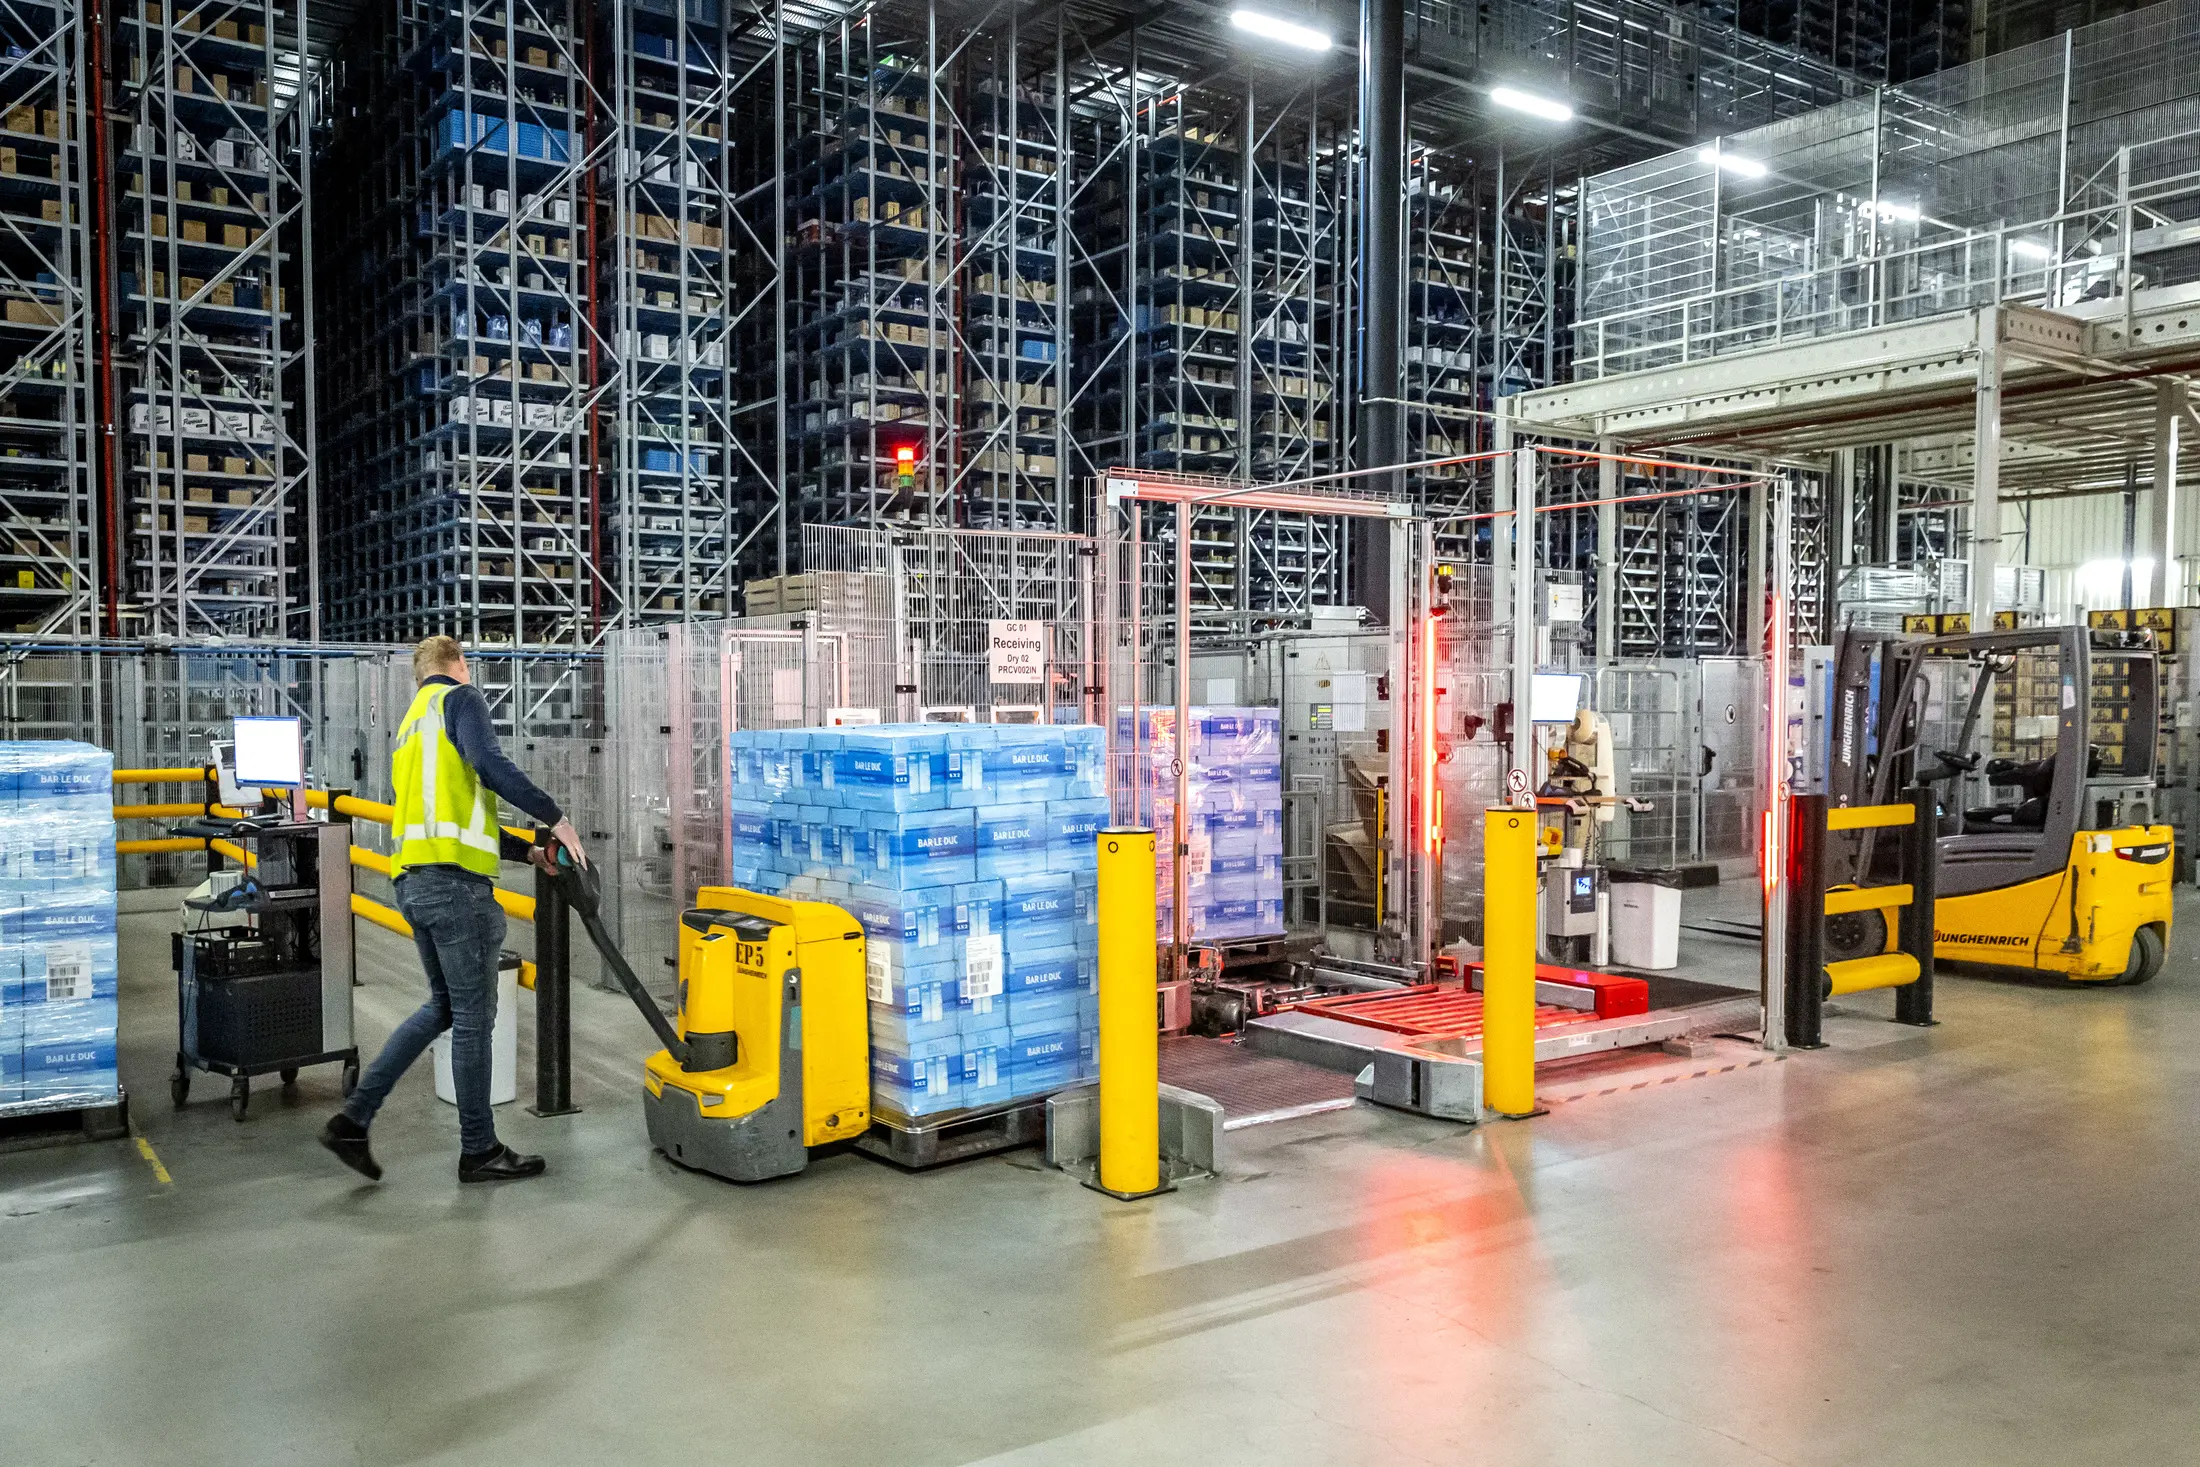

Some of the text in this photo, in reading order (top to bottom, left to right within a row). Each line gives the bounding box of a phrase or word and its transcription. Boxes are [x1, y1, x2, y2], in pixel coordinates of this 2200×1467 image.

[1006, 623, 1027, 632] GC 01
[993, 637, 1041, 652] Receiving
[1007, 654, 1029, 664] Dry 02
[998, 665, 1037, 674] PRCV002IN
[1842, 689, 1855, 767] JUNGHEINRICH
[854, 760, 882, 771] BAR LE DUC
[1012, 754, 1049, 764] BAR LE DUC
[40, 774, 92, 784] BAR LE DUC
[993, 828, 1031, 841] BAR LE DUC
[1062, 822, 1097, 834] BAR LE DUC
[917, 834, 958, 848] BAR LE DUC
[1022, 899, 1059, 913] BAR LE DUC
[44, 914, 97, 925] BAR LE DUC
[736, 942, 764, 967] EP 5
[1025, 971, 1062, 985] BAR LE DUC
[1027, 1042, 1064, 1057] BAR LE DUC
[45, 1051, 97, 1064] BAR LE DUC
